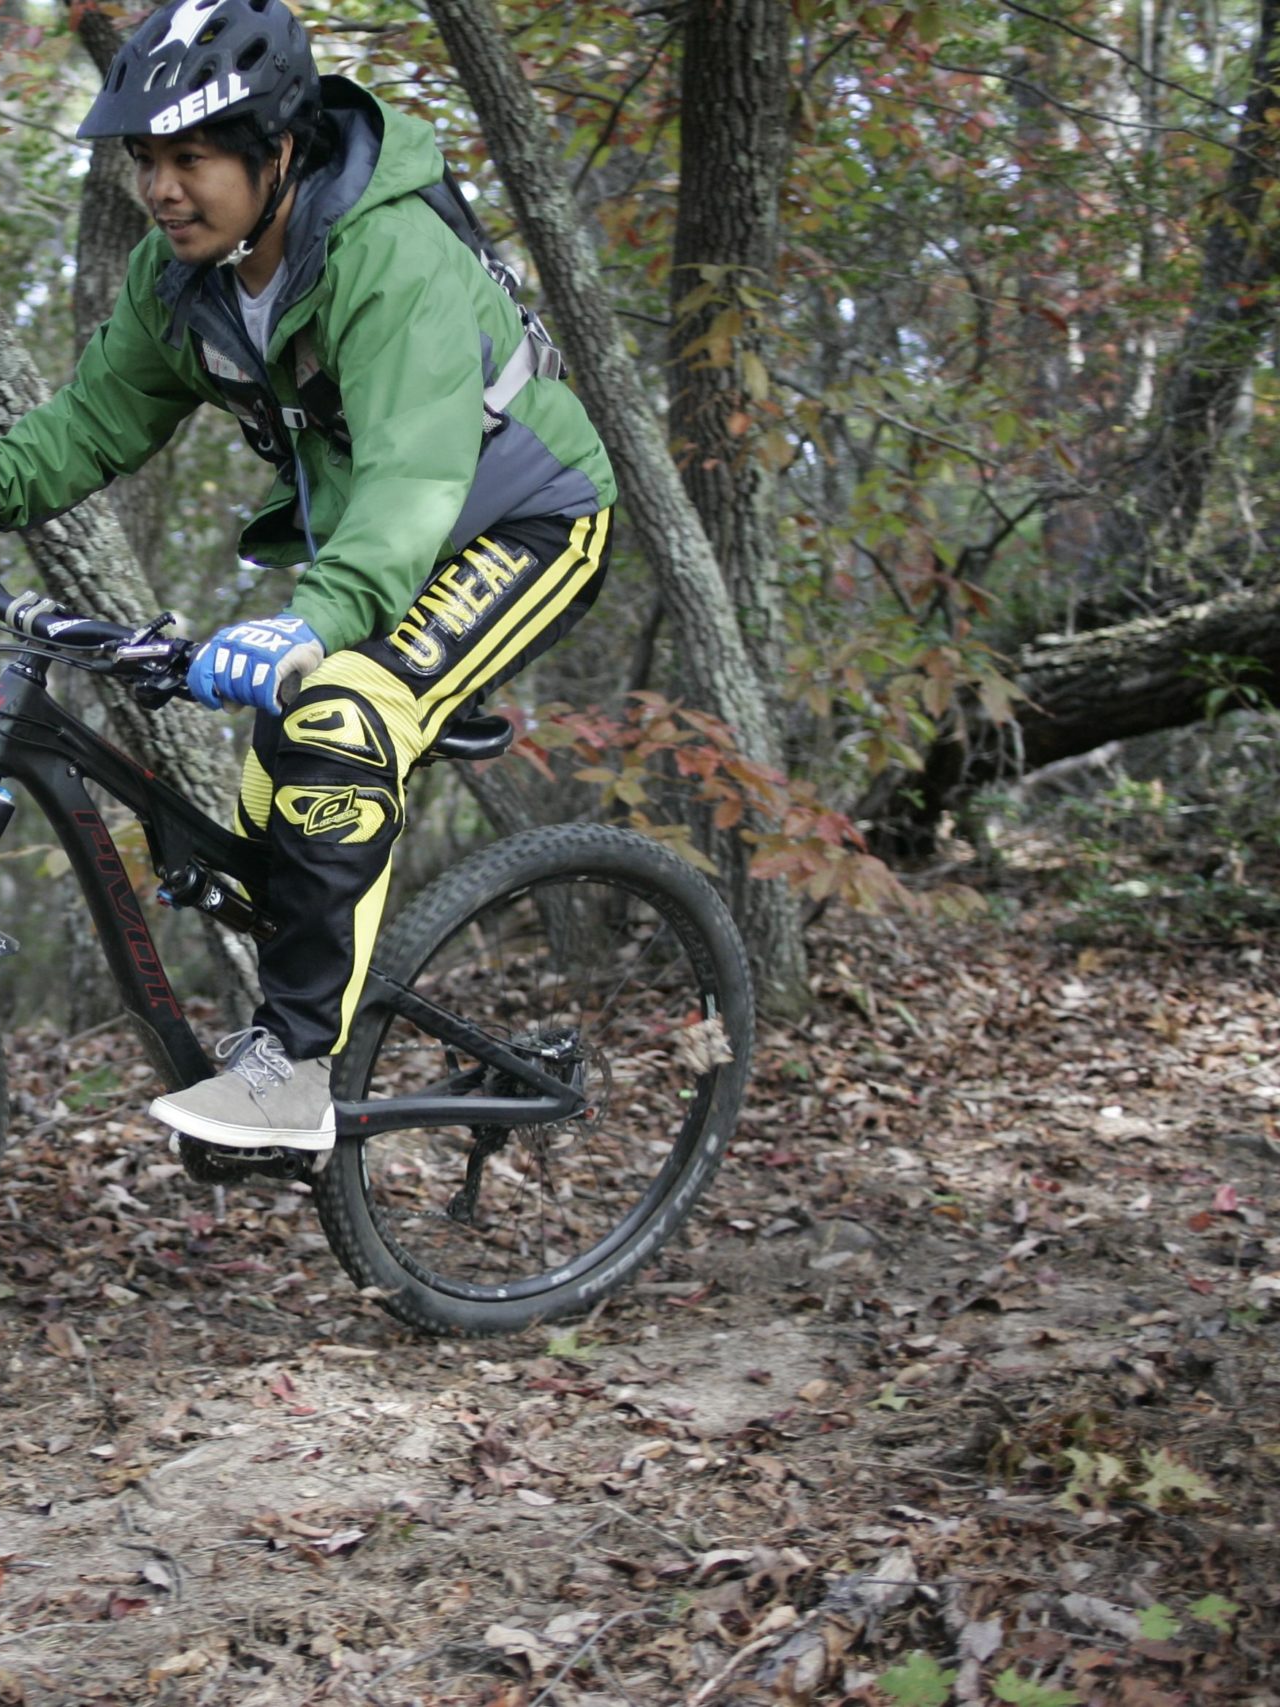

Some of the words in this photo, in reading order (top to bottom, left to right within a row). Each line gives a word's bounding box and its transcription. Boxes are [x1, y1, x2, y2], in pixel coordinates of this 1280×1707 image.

[150, 72, 250, 135] BELL
[226, 626, 292, 652] FOX
[388, 536, 530, 668] O'NEAL
[73, 809, 181, 1019] PIVOT
